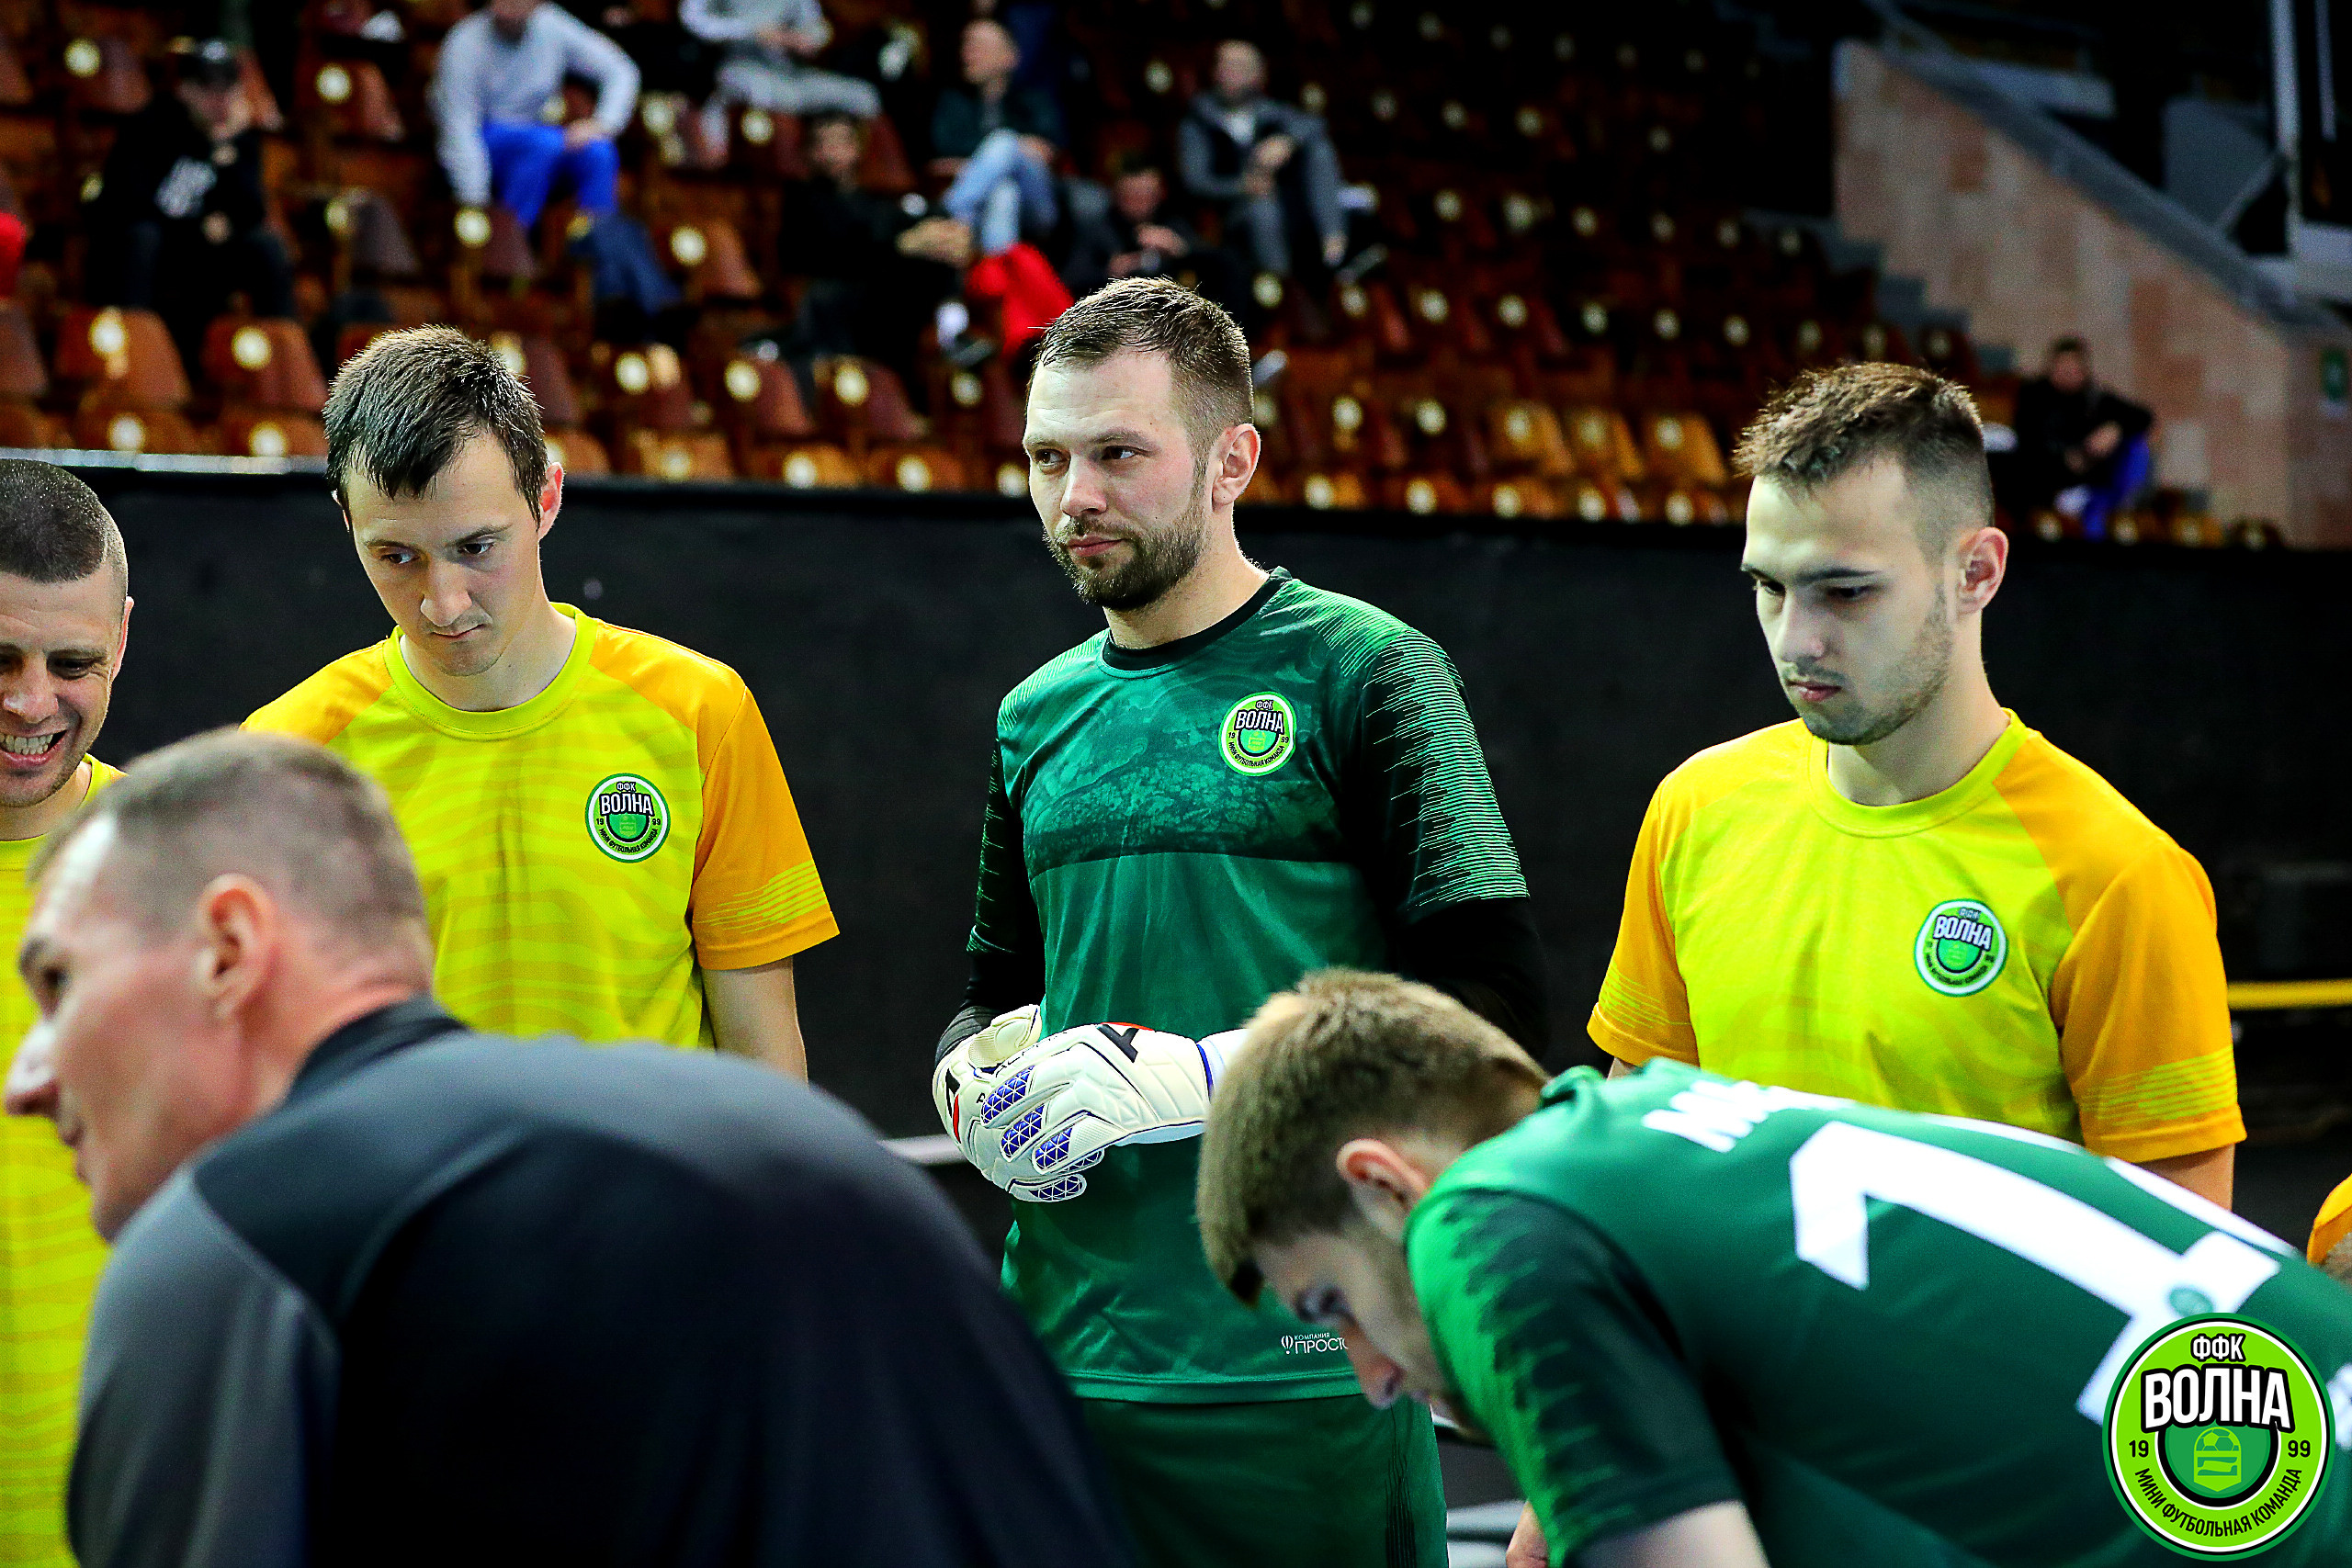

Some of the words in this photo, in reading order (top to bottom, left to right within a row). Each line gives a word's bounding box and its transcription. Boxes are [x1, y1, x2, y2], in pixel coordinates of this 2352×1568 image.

[1235, 710, 1283, 733] ВОЛНА
[616, 782, 636, 791] ФФК
[600, 793, 653, 815] ВОЛНА
[1933, 915, 1993, 951] ВОЛНА
[1294, 1332, 1330, 1341] КОМПАНИЯ
